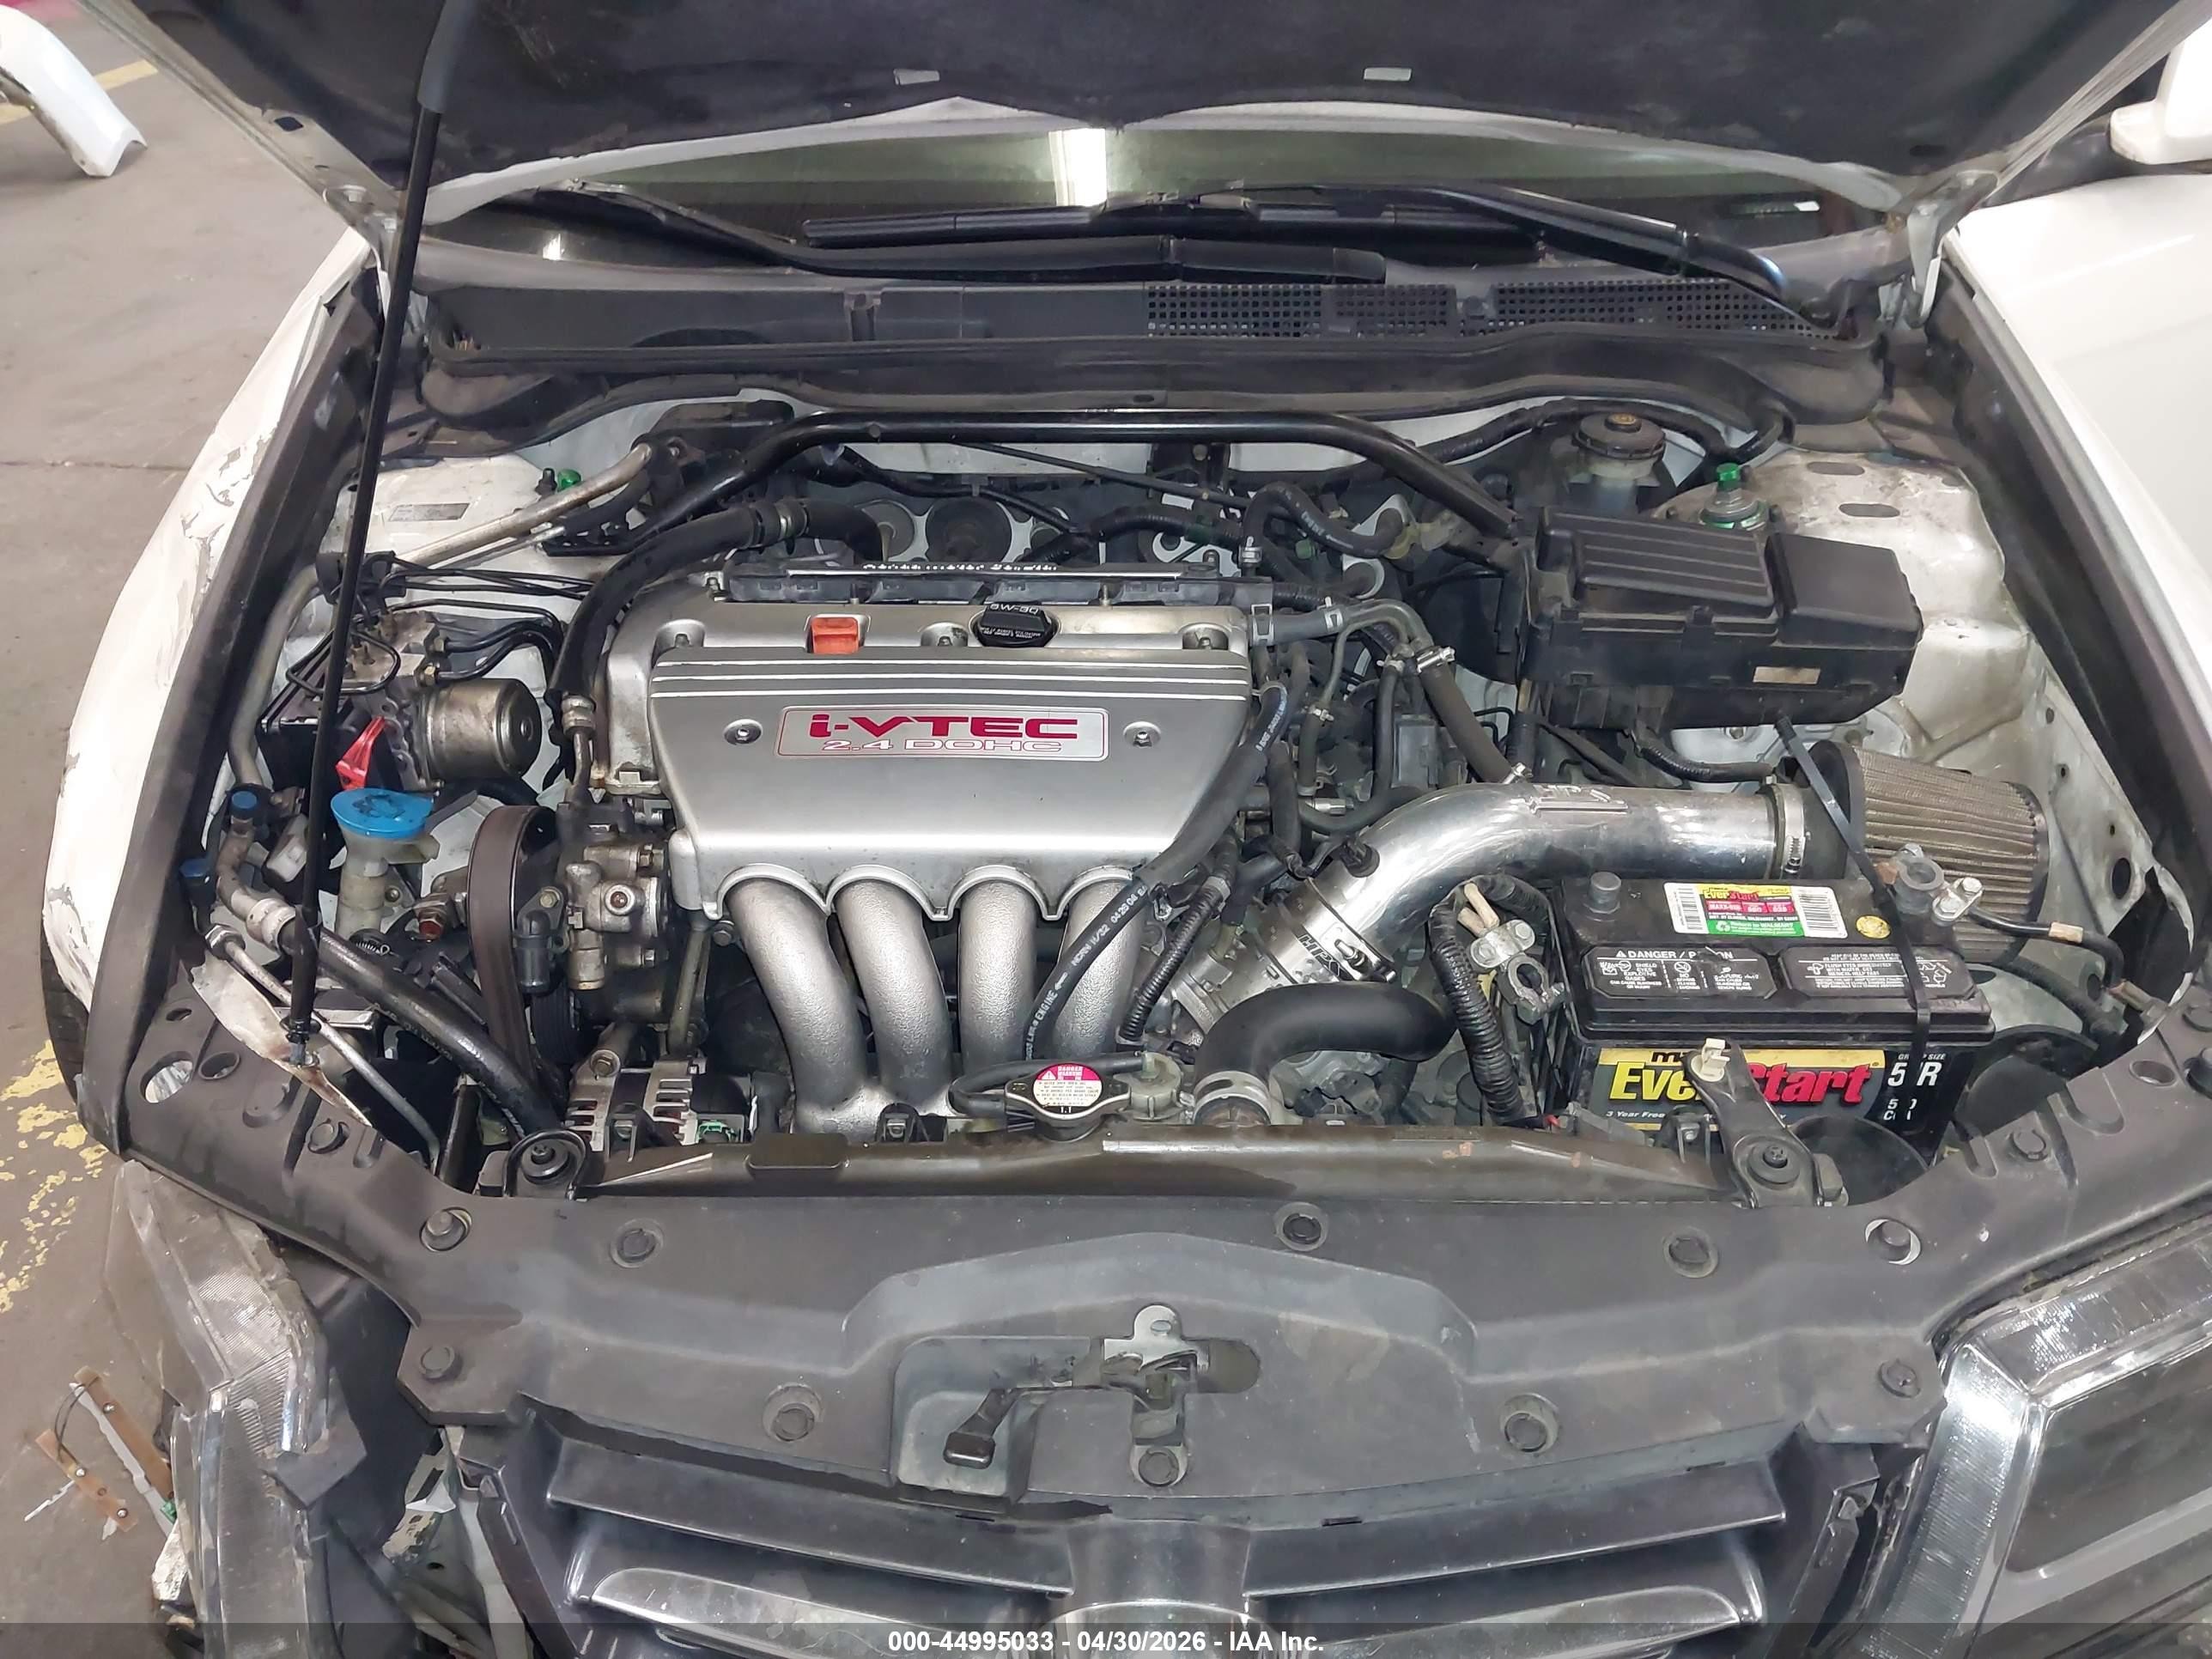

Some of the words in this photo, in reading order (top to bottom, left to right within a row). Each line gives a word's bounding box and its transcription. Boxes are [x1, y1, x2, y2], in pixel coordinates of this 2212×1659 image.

[810, 714, 1079, 738] i-VTEC
[823, 739, 894, 751] 2.4
[904, 739, 1062, 752] DOHC
[1627, 951, 1677, 959] DANGER
[1035, 989, 1058, 1021] ENGINE
